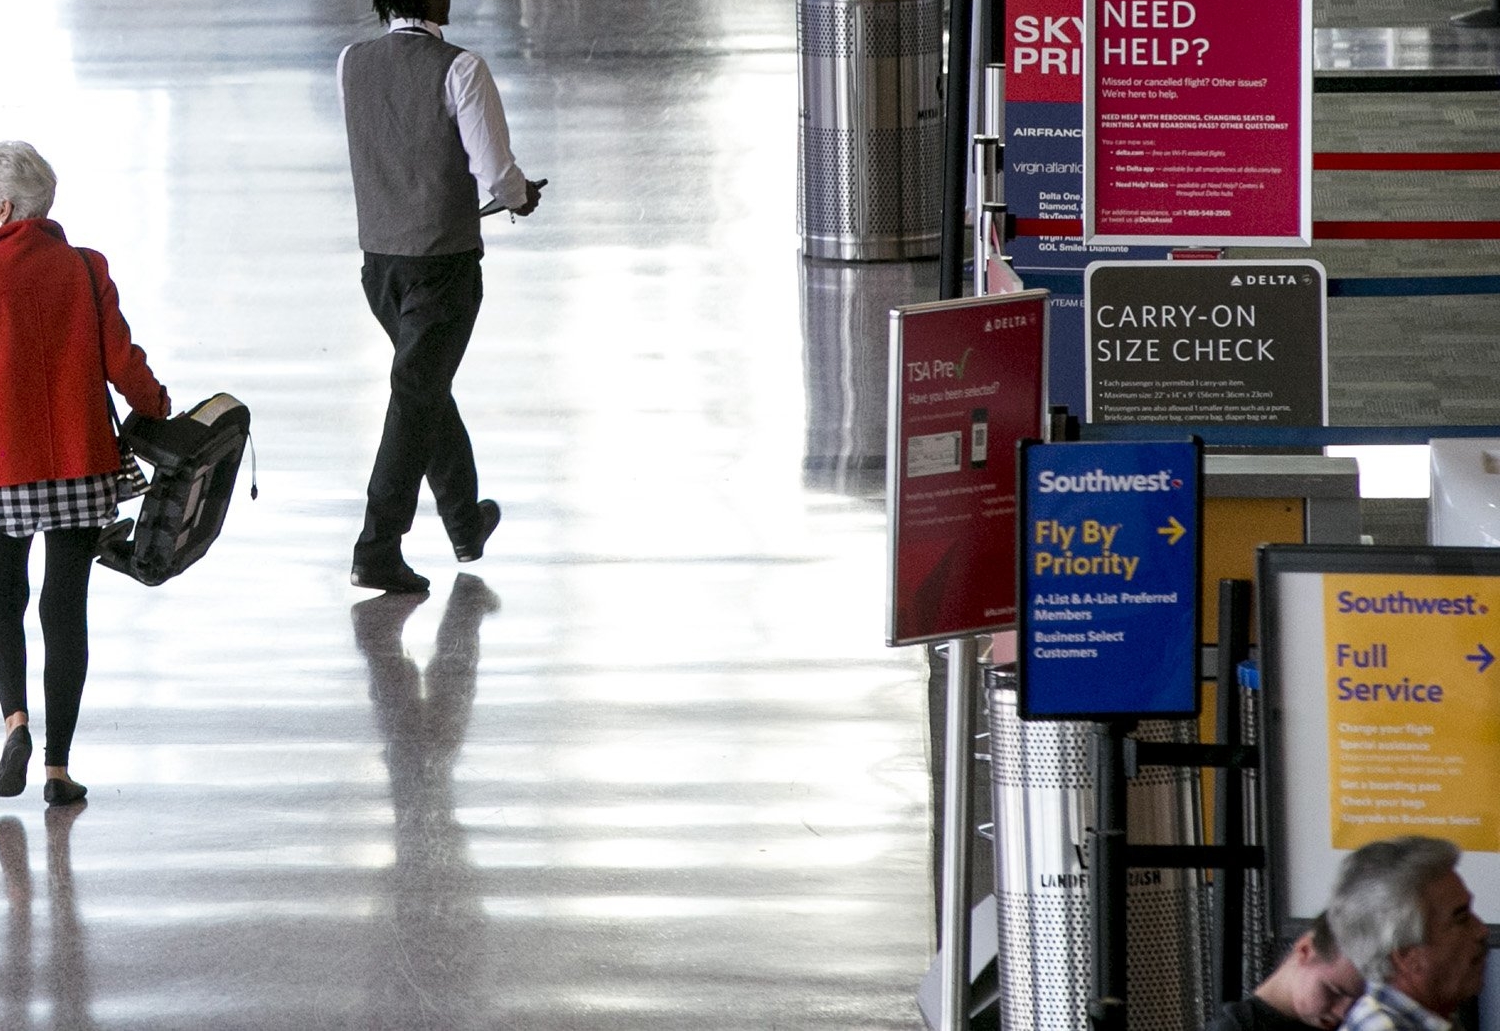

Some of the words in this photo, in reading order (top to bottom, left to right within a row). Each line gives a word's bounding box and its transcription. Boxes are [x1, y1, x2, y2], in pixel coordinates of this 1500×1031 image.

[1103, 0, 1196, 28] NEED
[1103, 38, 1209, 66] HELP?
[1102, 77, 1132, 86] Missed
[1144, 78, 1183, 86] cancelled
[1184, 78, 1210, 88] flight?
[1211, 78, 1236, 87] Other
[1237, 78, 1268, 87] issues?
[1102, 90, 1126, 98] We're
[1128, 90, 1148, 98] here
[1148, 90, 1157, 98] to
[1158, 90, 1179, 100] help.
[1013, 128, 1083, 137] AIRFRANC
[1013, 162, 1044, 175] virgin
[1039, 192, 1061, 200] Delta
[1039, 202, 1079, 211] Diamond,
[1039, 243, 1057, 251] GOL
[1059, 243, 1087, 252] Smiles
[1090, 245, 1129, 253] Diamante
[1247, 275, 1297, 285] DELTA
[994, 316, 1027, 329] DELTA
[1097, 305, 1256, 328] CARRY-ON
[1097, 339, 1160, 362] SIZE
[1173, 339, 1275, 362] CHECK
[907, 362, 931, 382] TSA
[933, 360, 955, 379] Pre
[1104, 379, 1120, 387] Each
[1121, 380, 1154, 388] passenger
[1161, 380, 1194, 388] permitted
[908, 391, 928, 404] Have
[929, 392, 944, 405] you
[945, 388, 964, 401] been
[964, 381, 1000, 398] selected?
[1251, 391, 1274, 399] 23cm)
[1039, 469, 1170, 493] Southwest
[1035, 520, 1076, 550] Fly
[1083, 520, 1119, 549] By
[1035, 551, 1140, 581] Priority
[1034, 594, 1069, 605] A-List
[1071, 594, 1081, 604] &
[1083, 593, 1118, 604] A-List
[1121, 591, 1178, 604] Preferred
[1338, 591, 1476, 615] Southwest
[1034, 609, 1092, 621] Members
[1034, 631, 1086, 643] Business
[1087, 630, 1125, 642] Select
[1034, 647, 1098, 658] Customers
[1337, 644, 1387, 668] Full
[1338, 677, 1443, 702] Service
[1368, 781, 1417, 793] boarding
